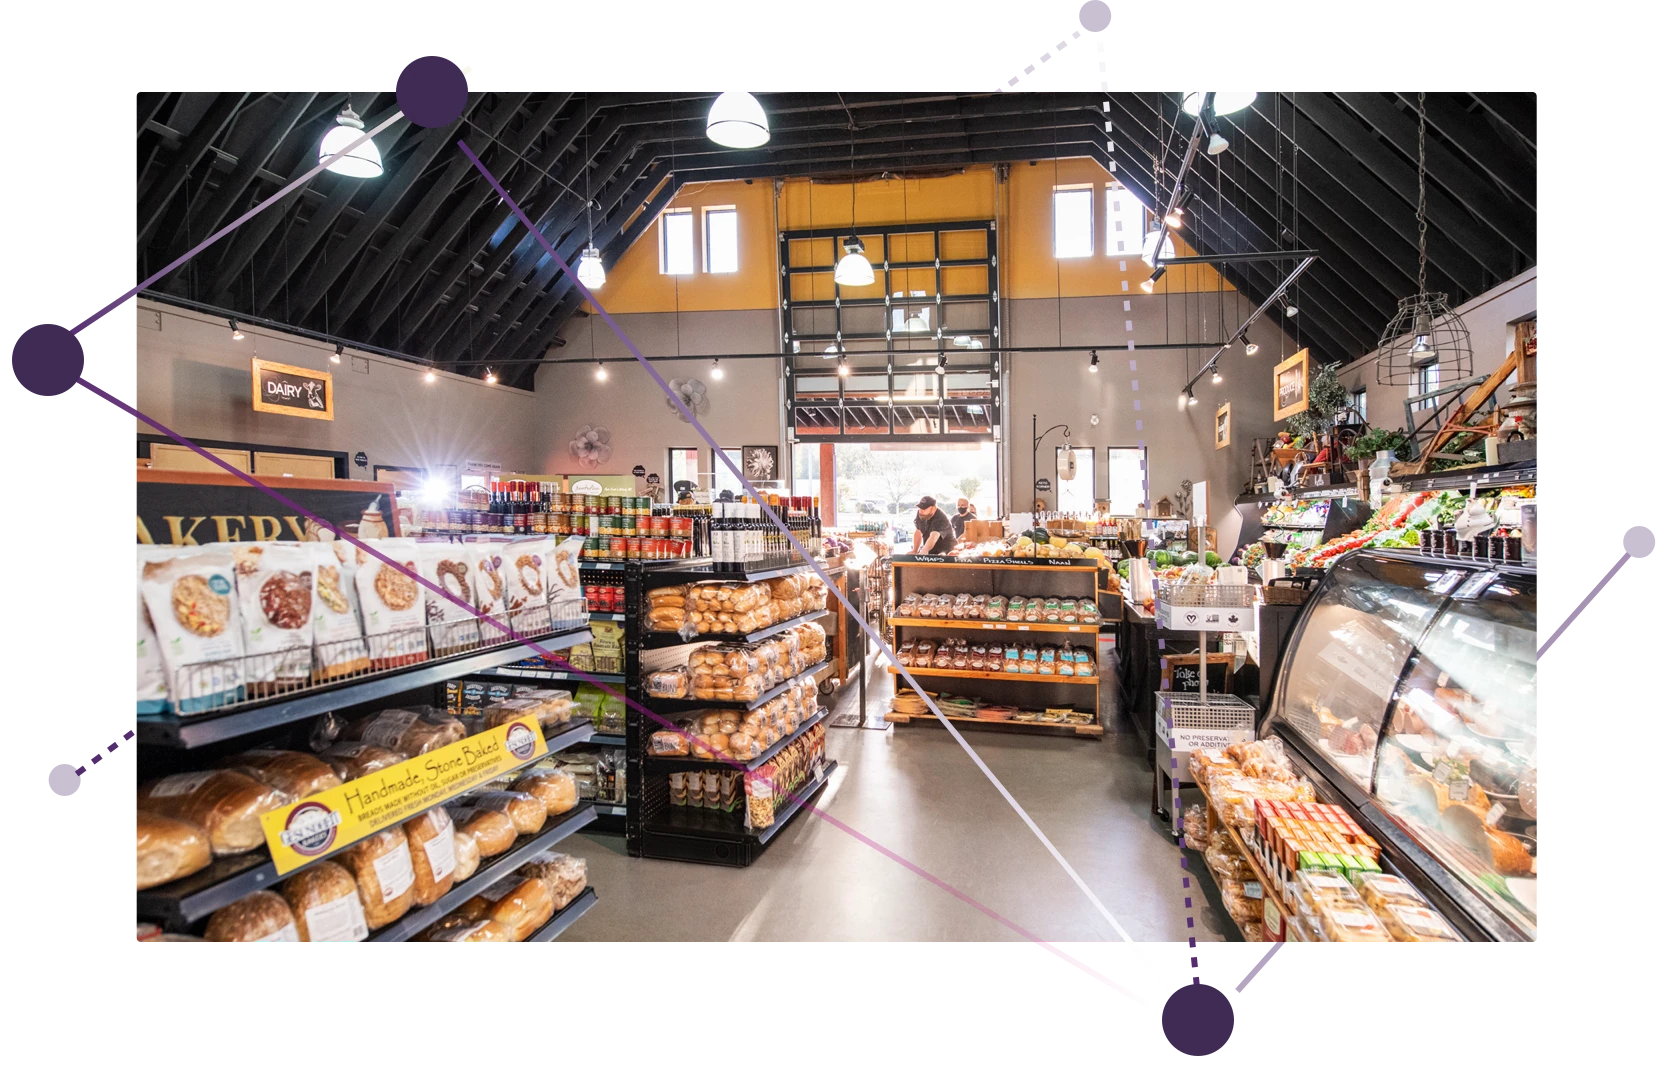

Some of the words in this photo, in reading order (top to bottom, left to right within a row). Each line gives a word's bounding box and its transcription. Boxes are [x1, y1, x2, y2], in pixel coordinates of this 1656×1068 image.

[267, 381, 302, 398] DAIRY
[1174, 667, 1195, 679] Take
[344, 768, 424, 814] Handmade,
[425, 757, 463, 781] Stone
[462, 735, 499, 766] Baked
